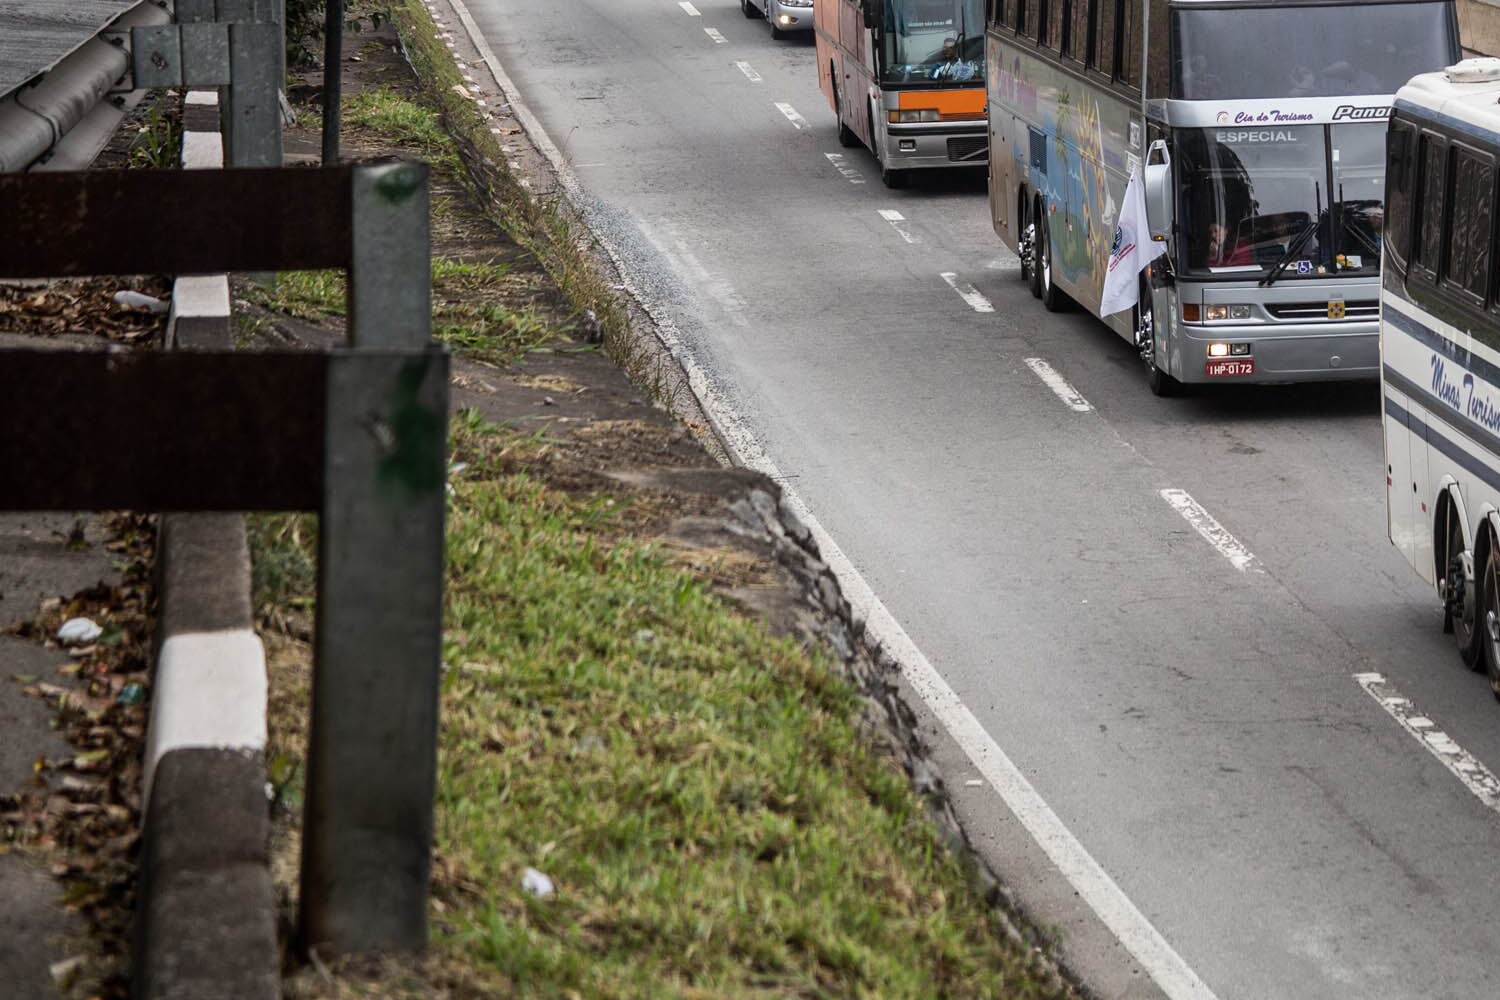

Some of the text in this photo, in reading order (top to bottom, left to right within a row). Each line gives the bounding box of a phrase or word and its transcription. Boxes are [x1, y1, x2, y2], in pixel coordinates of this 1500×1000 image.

[1270, 110, 1314, 122] Turismo
[1216, 131, 1297, 143] ESPECIAL
[1431, 353, 1461, 411] Minas
